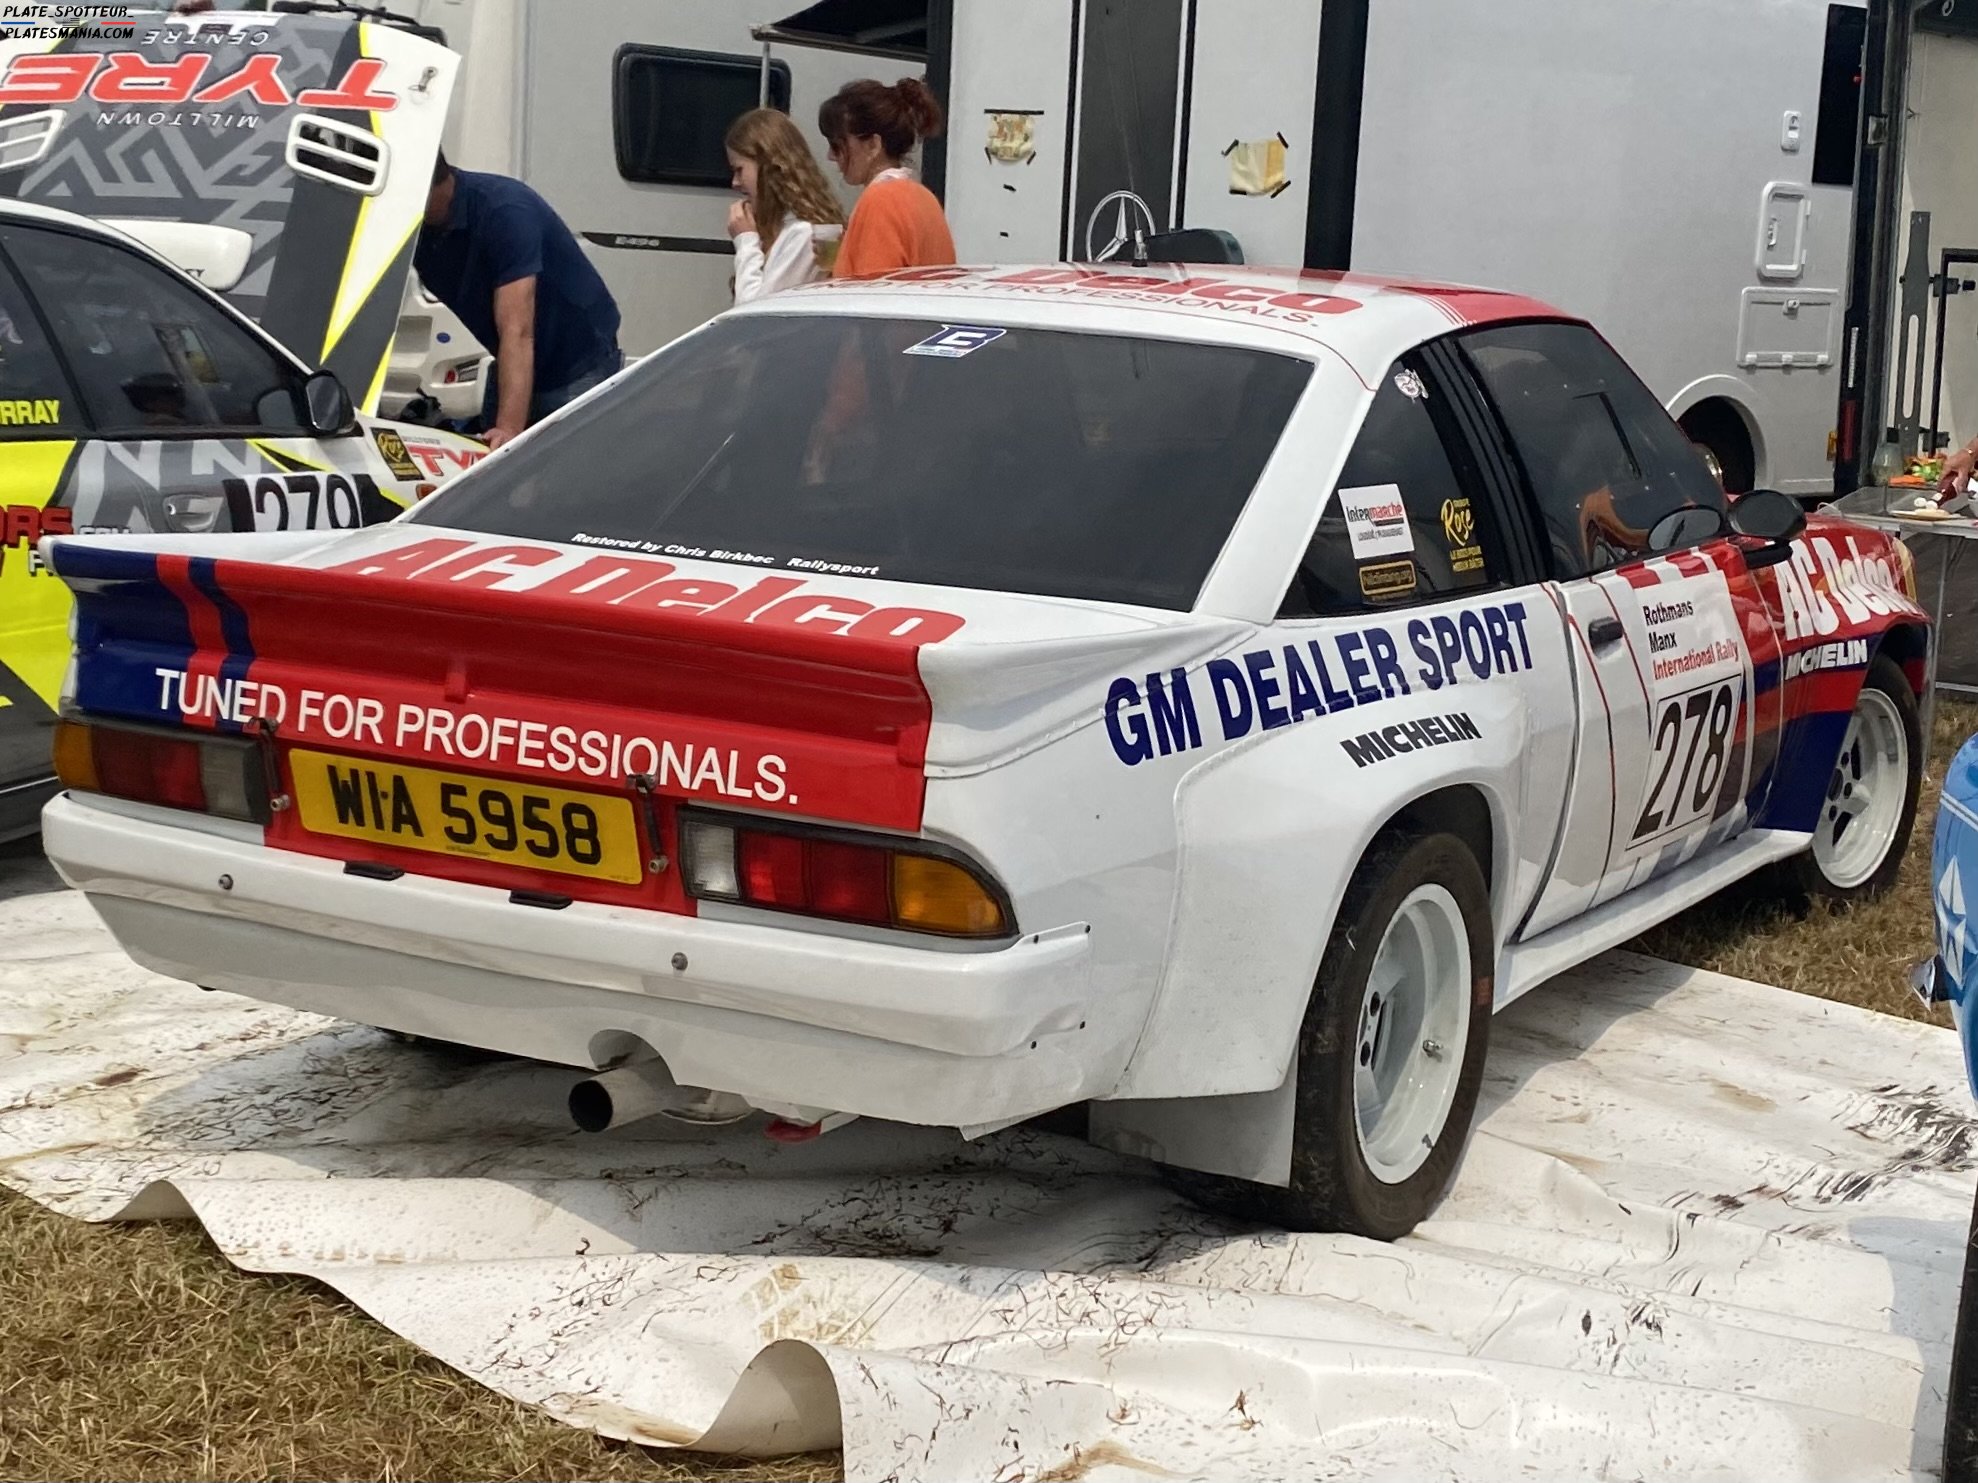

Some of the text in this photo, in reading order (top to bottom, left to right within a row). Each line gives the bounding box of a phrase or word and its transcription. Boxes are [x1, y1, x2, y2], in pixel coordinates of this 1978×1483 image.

[141, 30, 269, 47] CENTRE
[0, 52, 399, 110] TYRE
[97, 111, 259, 129] MILLTOWN
[985, 266, 1363, 315] Delco
[0, 400, 61, 425] RRAY
[571, 533, 639, 549] Restored
[640, 541, 661, 554] by
[664, 544, 706, 557] Chris
[786, 556, 880, 576] Rallysport
[321, 537, 966, 645] AC Delco
[1642, 600, 1694, 626] Rothmans
[1773, 538, 1839, 641] AC
[1648, 631, 1678, 653] Manx
[1653, 637, 1739, 680] International Rally
[1785, 639, 1868, 681] MICHELIN
[1104, 602, 1533, 766] GM DEALER SPORT
[155, 667, 799, 806] TUNED FOR PROFESSIONALS.
[1339, 712, 1483, 769] MICHELIN
[1631, 684, 1733, 841] 278
[327, 764, 602, 866] WIA 5958
